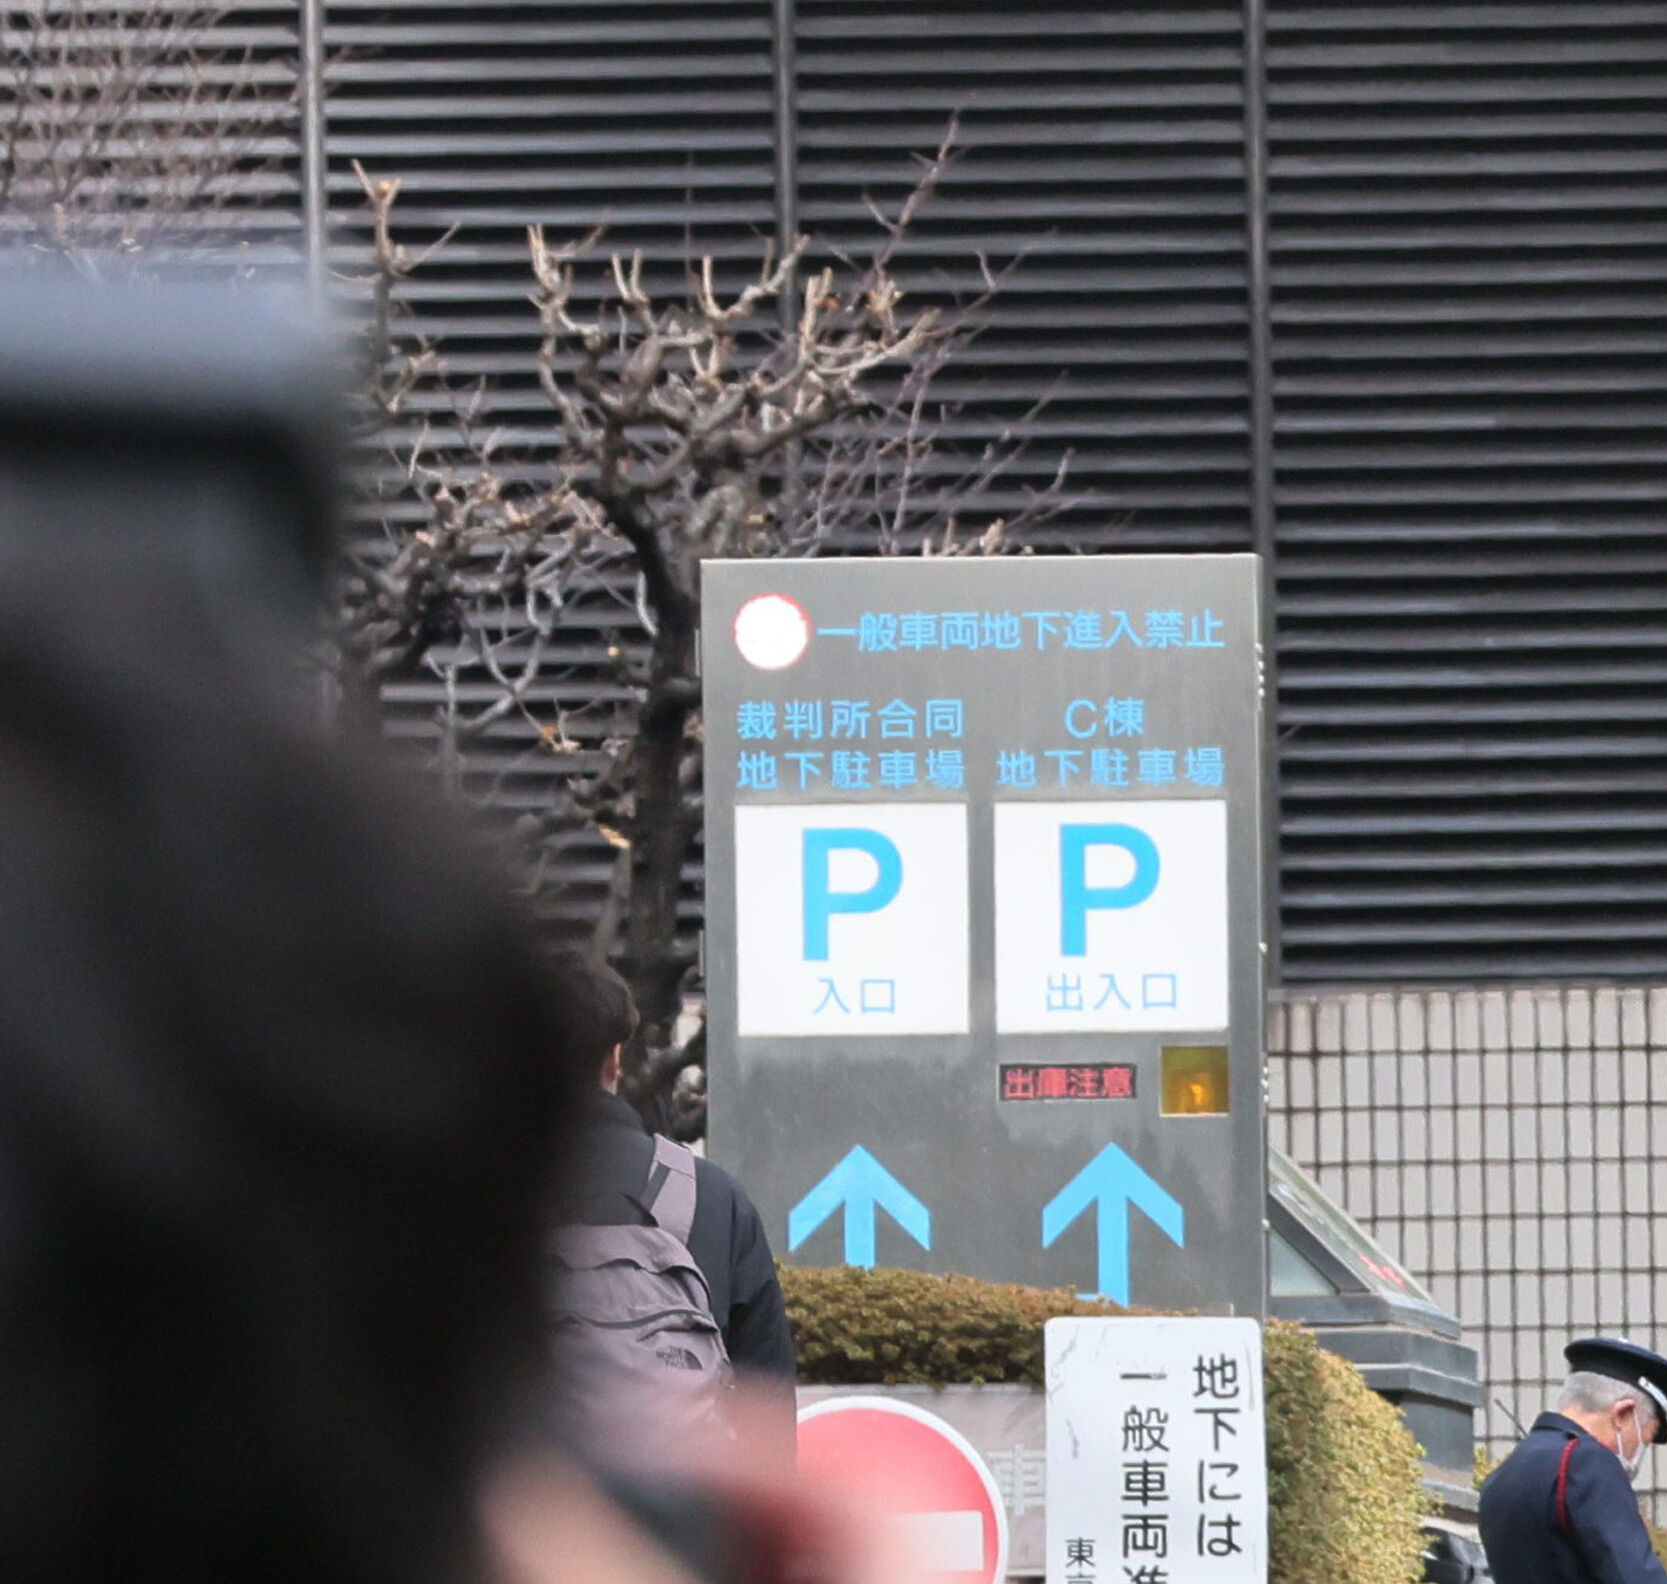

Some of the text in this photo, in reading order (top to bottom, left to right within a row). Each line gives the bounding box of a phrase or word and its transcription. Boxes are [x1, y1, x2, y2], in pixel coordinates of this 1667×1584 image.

[818, 610, 1226, 652] 一般車両地下進入禁止
[737, 700, 964, 740] 裁判所合同
[1064, 696, 1145, 739] C棟
[737, 750, 965, 790] 地下駐車場
[996, 748, 1226, 788] 地下駐車場
[802, 828, 904, 960] P
[1059, 823, 1160, 956] P
[813, 977, 895, 1015] 入口
[1046, 972, 1178, 1012] 出入口
[1192, 1354, 1243, 1558] 地下には
